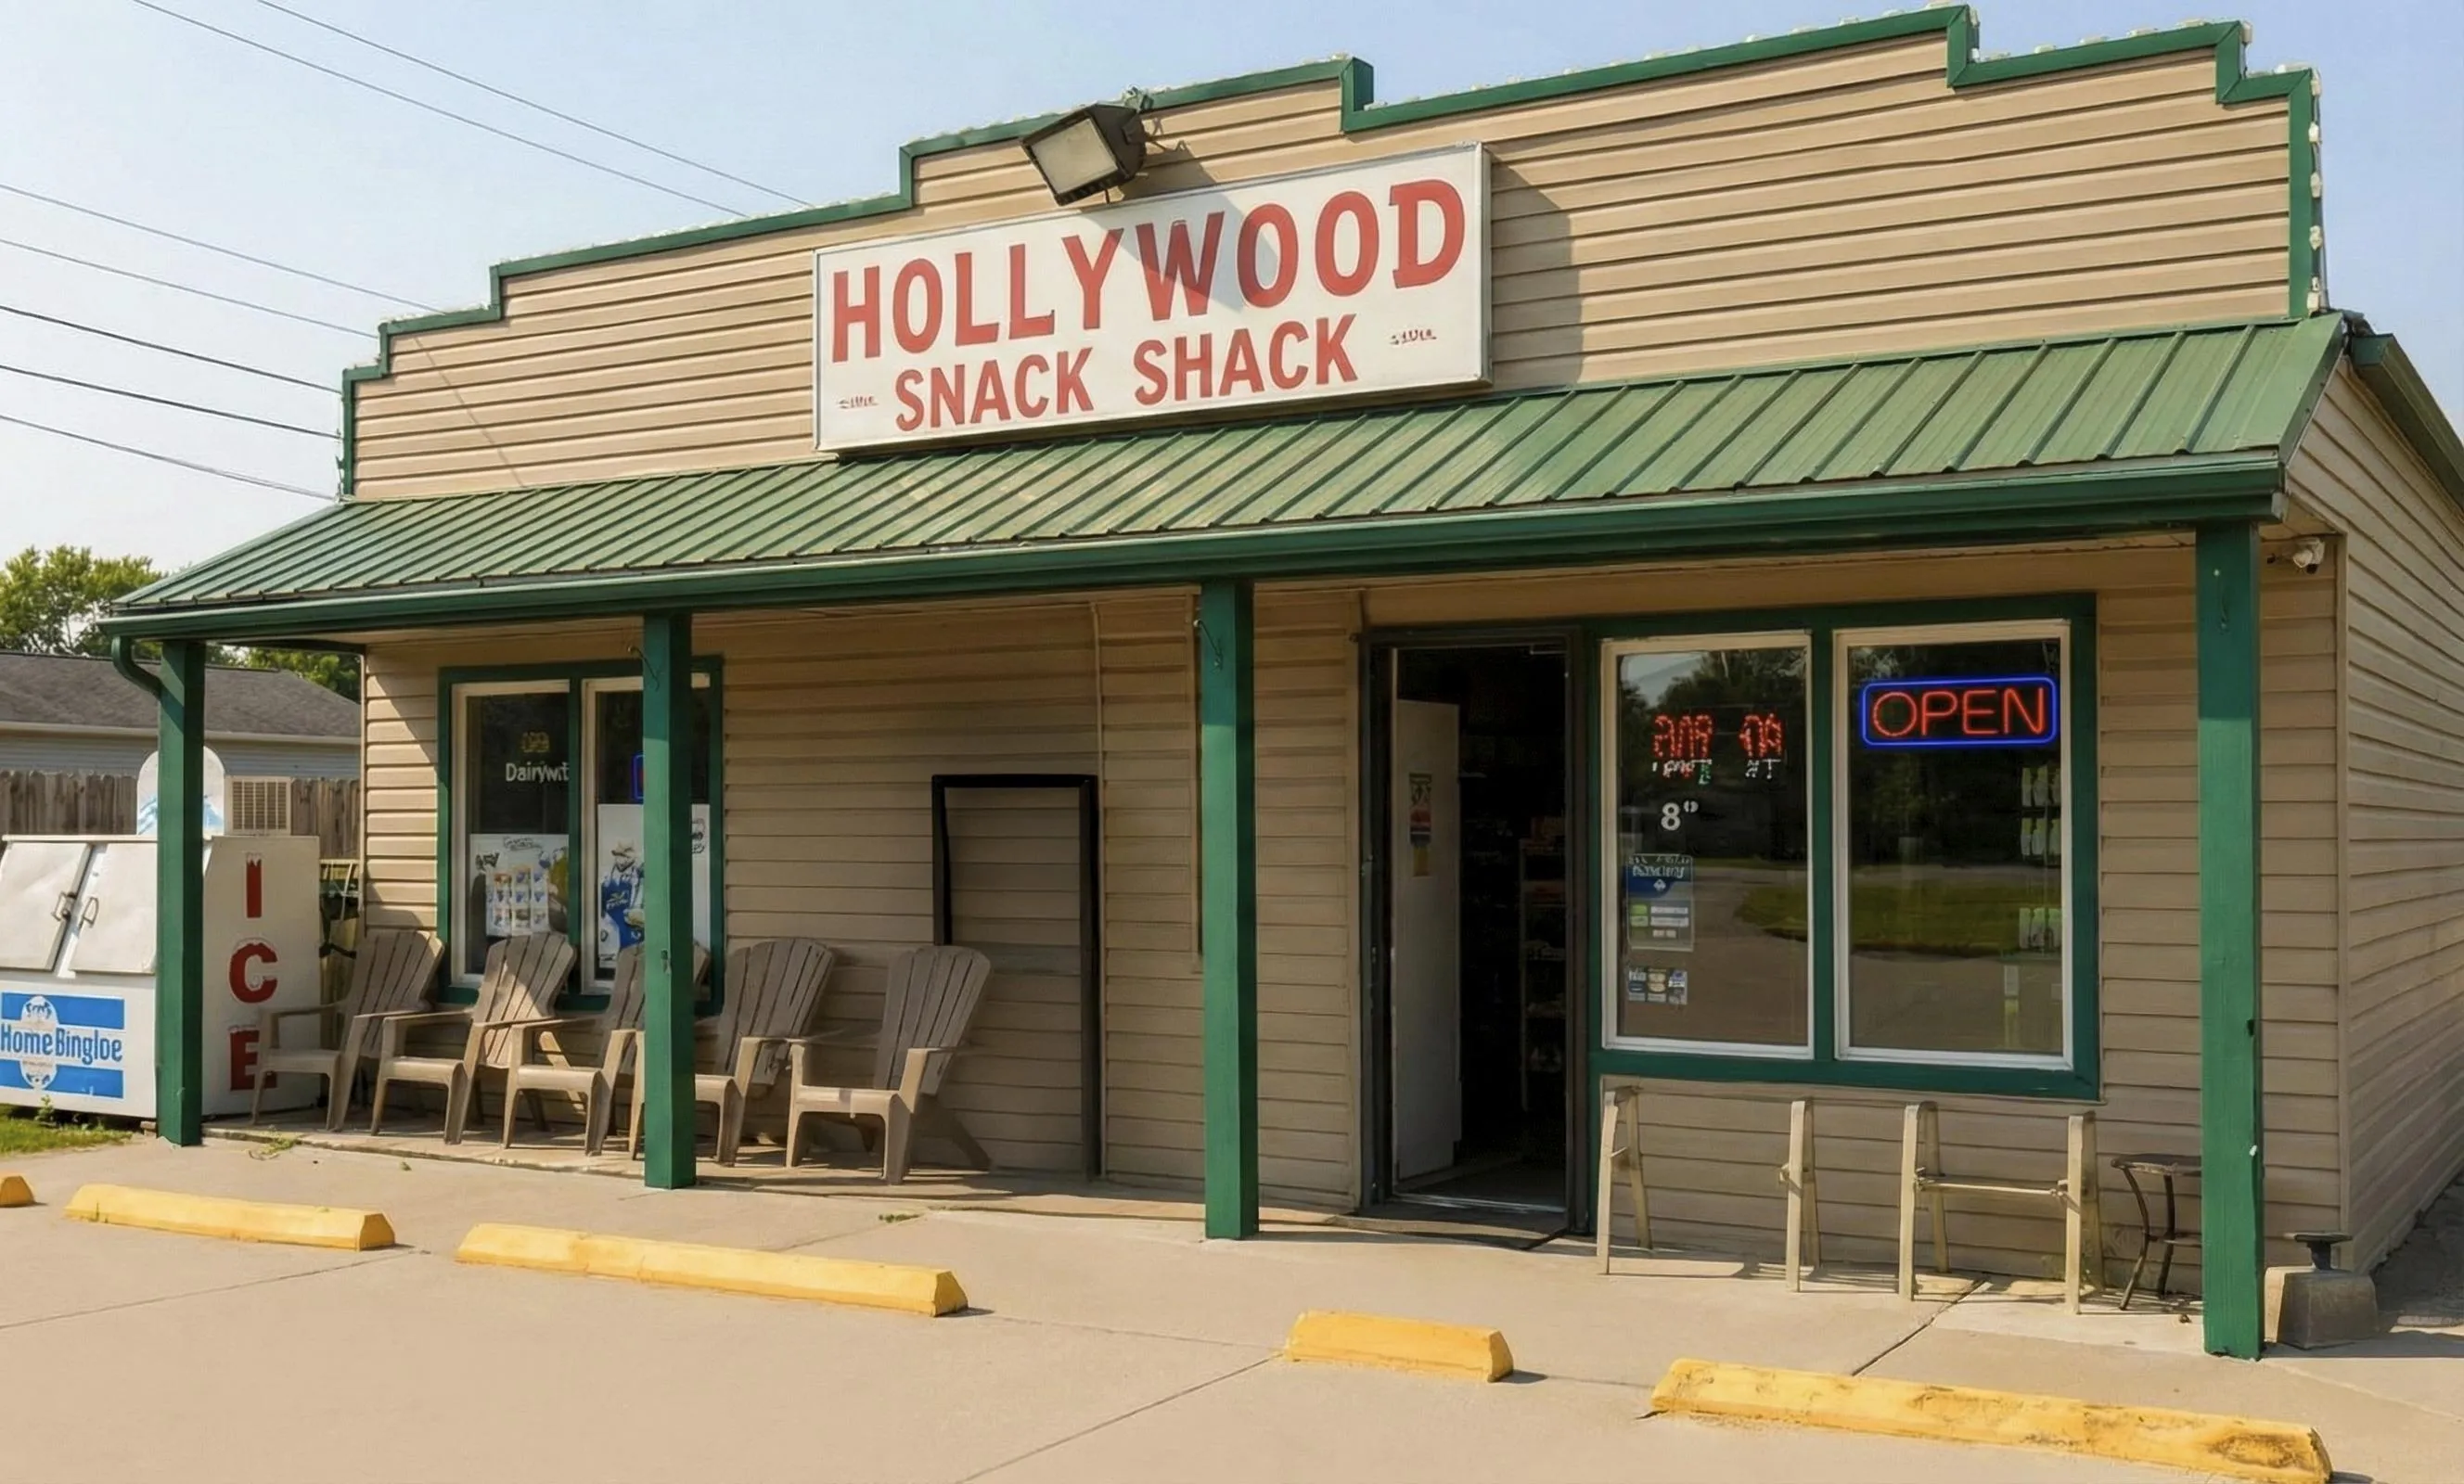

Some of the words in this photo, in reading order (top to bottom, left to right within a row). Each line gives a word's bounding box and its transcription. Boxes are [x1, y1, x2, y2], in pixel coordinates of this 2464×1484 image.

[832, 179, 1466, 364] HOLLYWOOD
[895, 348, 1093, 432] SNACK
[1134, 313, 1357, 406] SHACK
[1872, 687, 2045, 737] OPEN
[228, 853, 277, 1092] ICE
